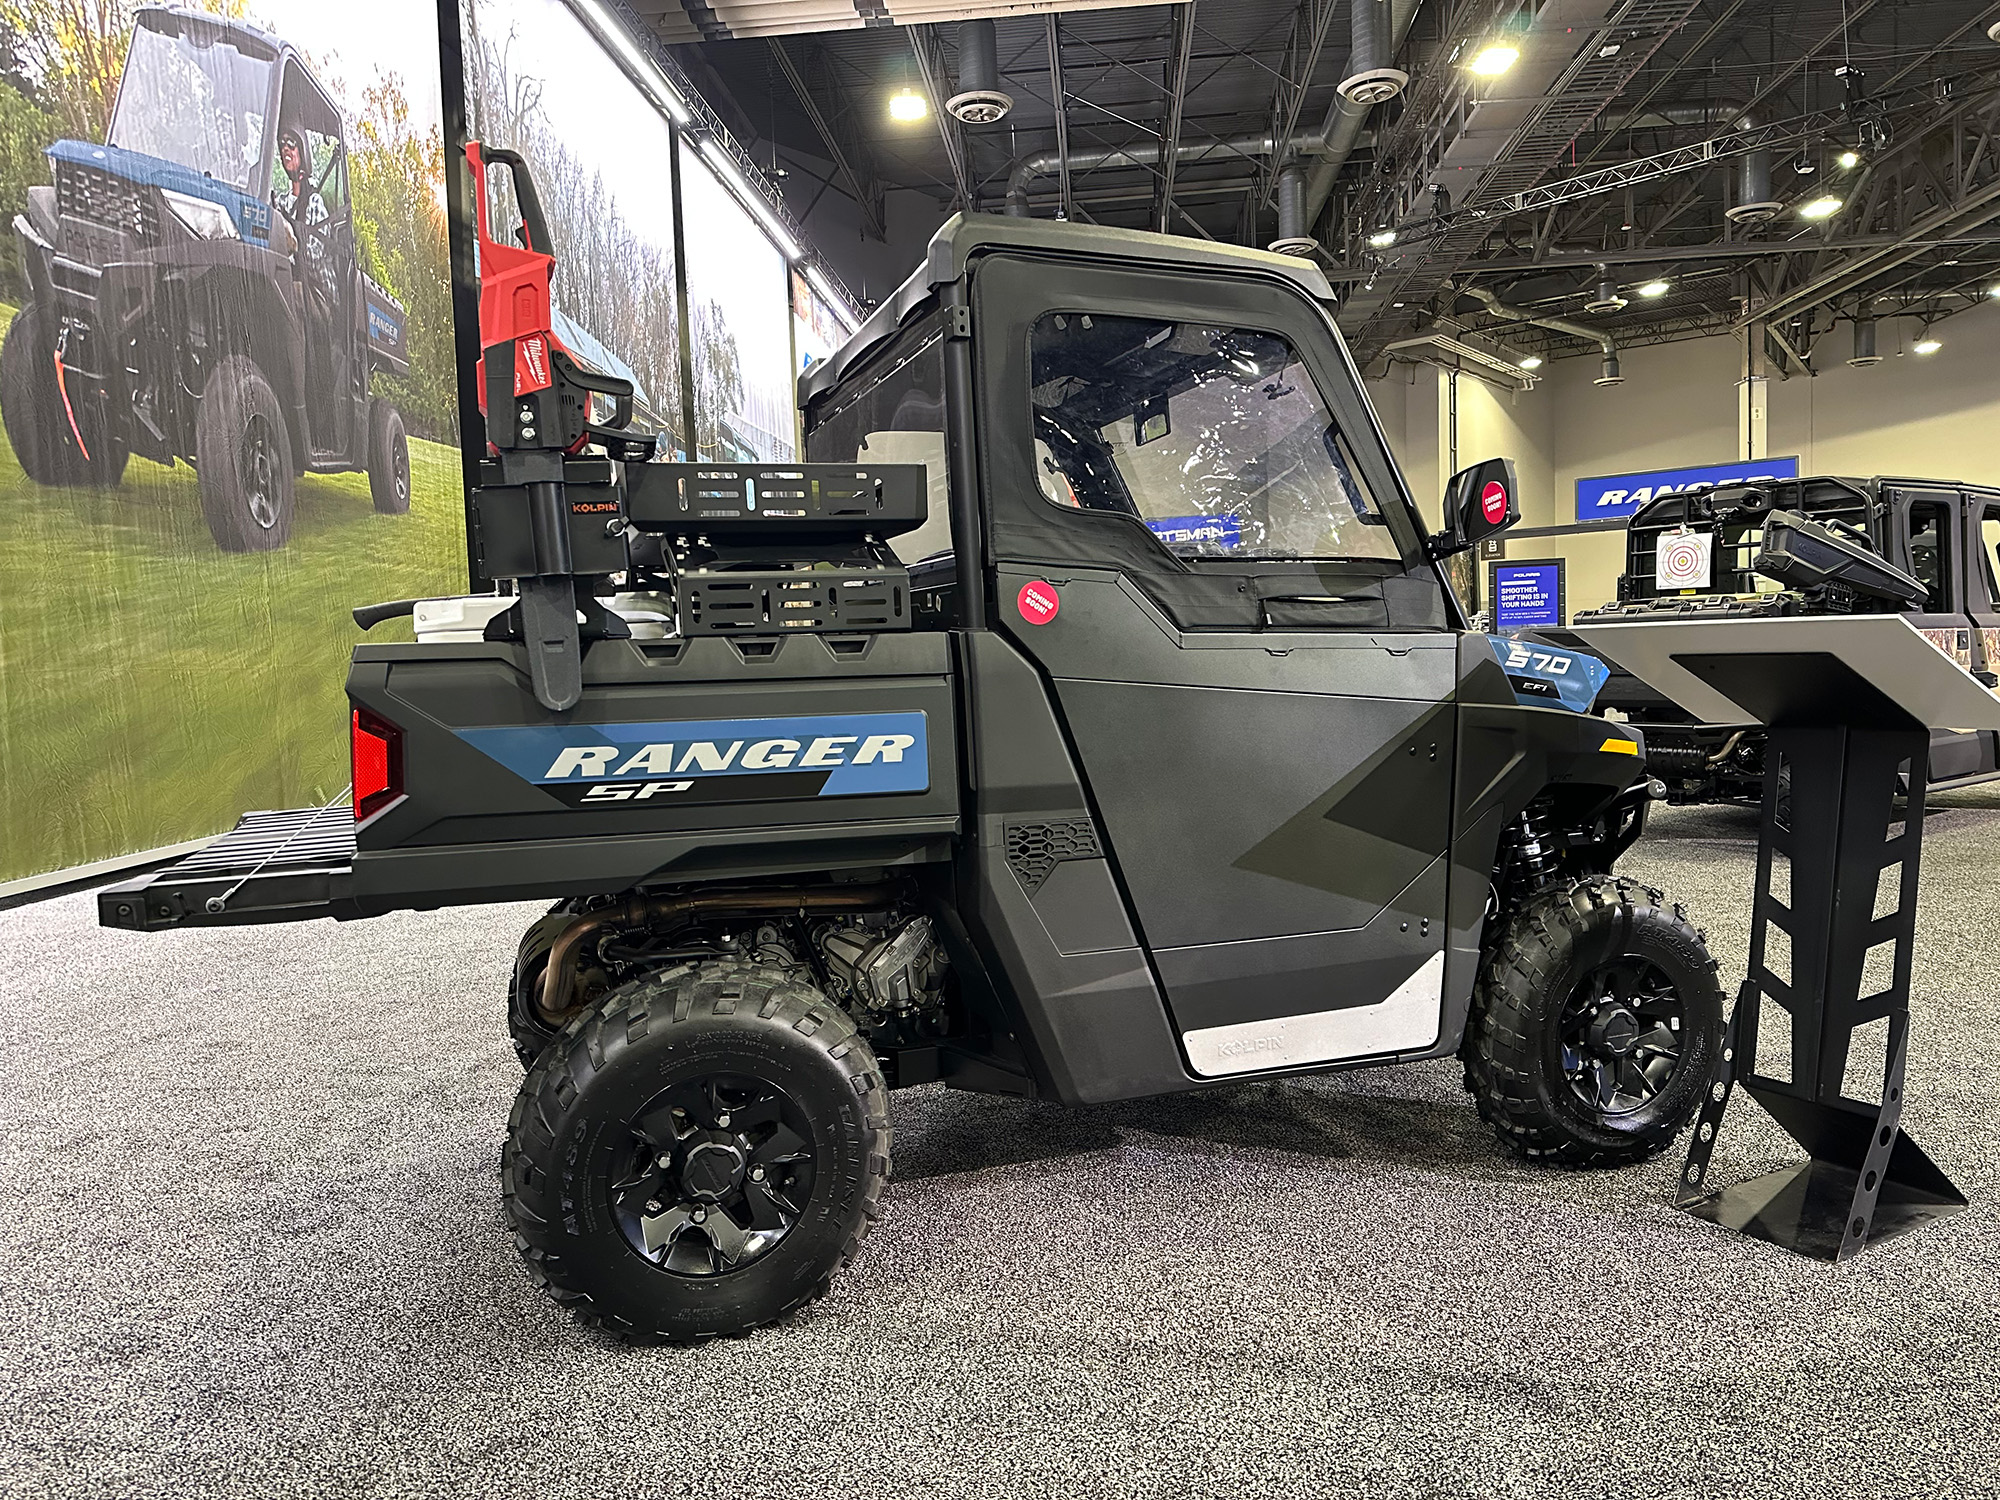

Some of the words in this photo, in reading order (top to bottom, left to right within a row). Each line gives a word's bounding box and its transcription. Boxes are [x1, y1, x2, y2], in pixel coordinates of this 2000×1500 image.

[370, 312, 399, 340] RANGER
[527, 337, 546, 385] Milwaukee
[572, 503, 618, 513] KOLPIN
[1027, 588, 1054, 610] COMING
[1501, 586, 1538, 595] SMOOTHER
[1501, 594, 1532, 602] SHIFTING
[1025, 596, 1048, 615] SOON!
[1520, 600, 1545, 608] HANDS
[1504, 650, 1572, 675] 570
[1522, 682, 1548, 691] EFI
[544, 734, 915, 779] RANGER
[580, 780, 695, 803] SP
[1217, 1036, 1284, 1058] KOLPIN
